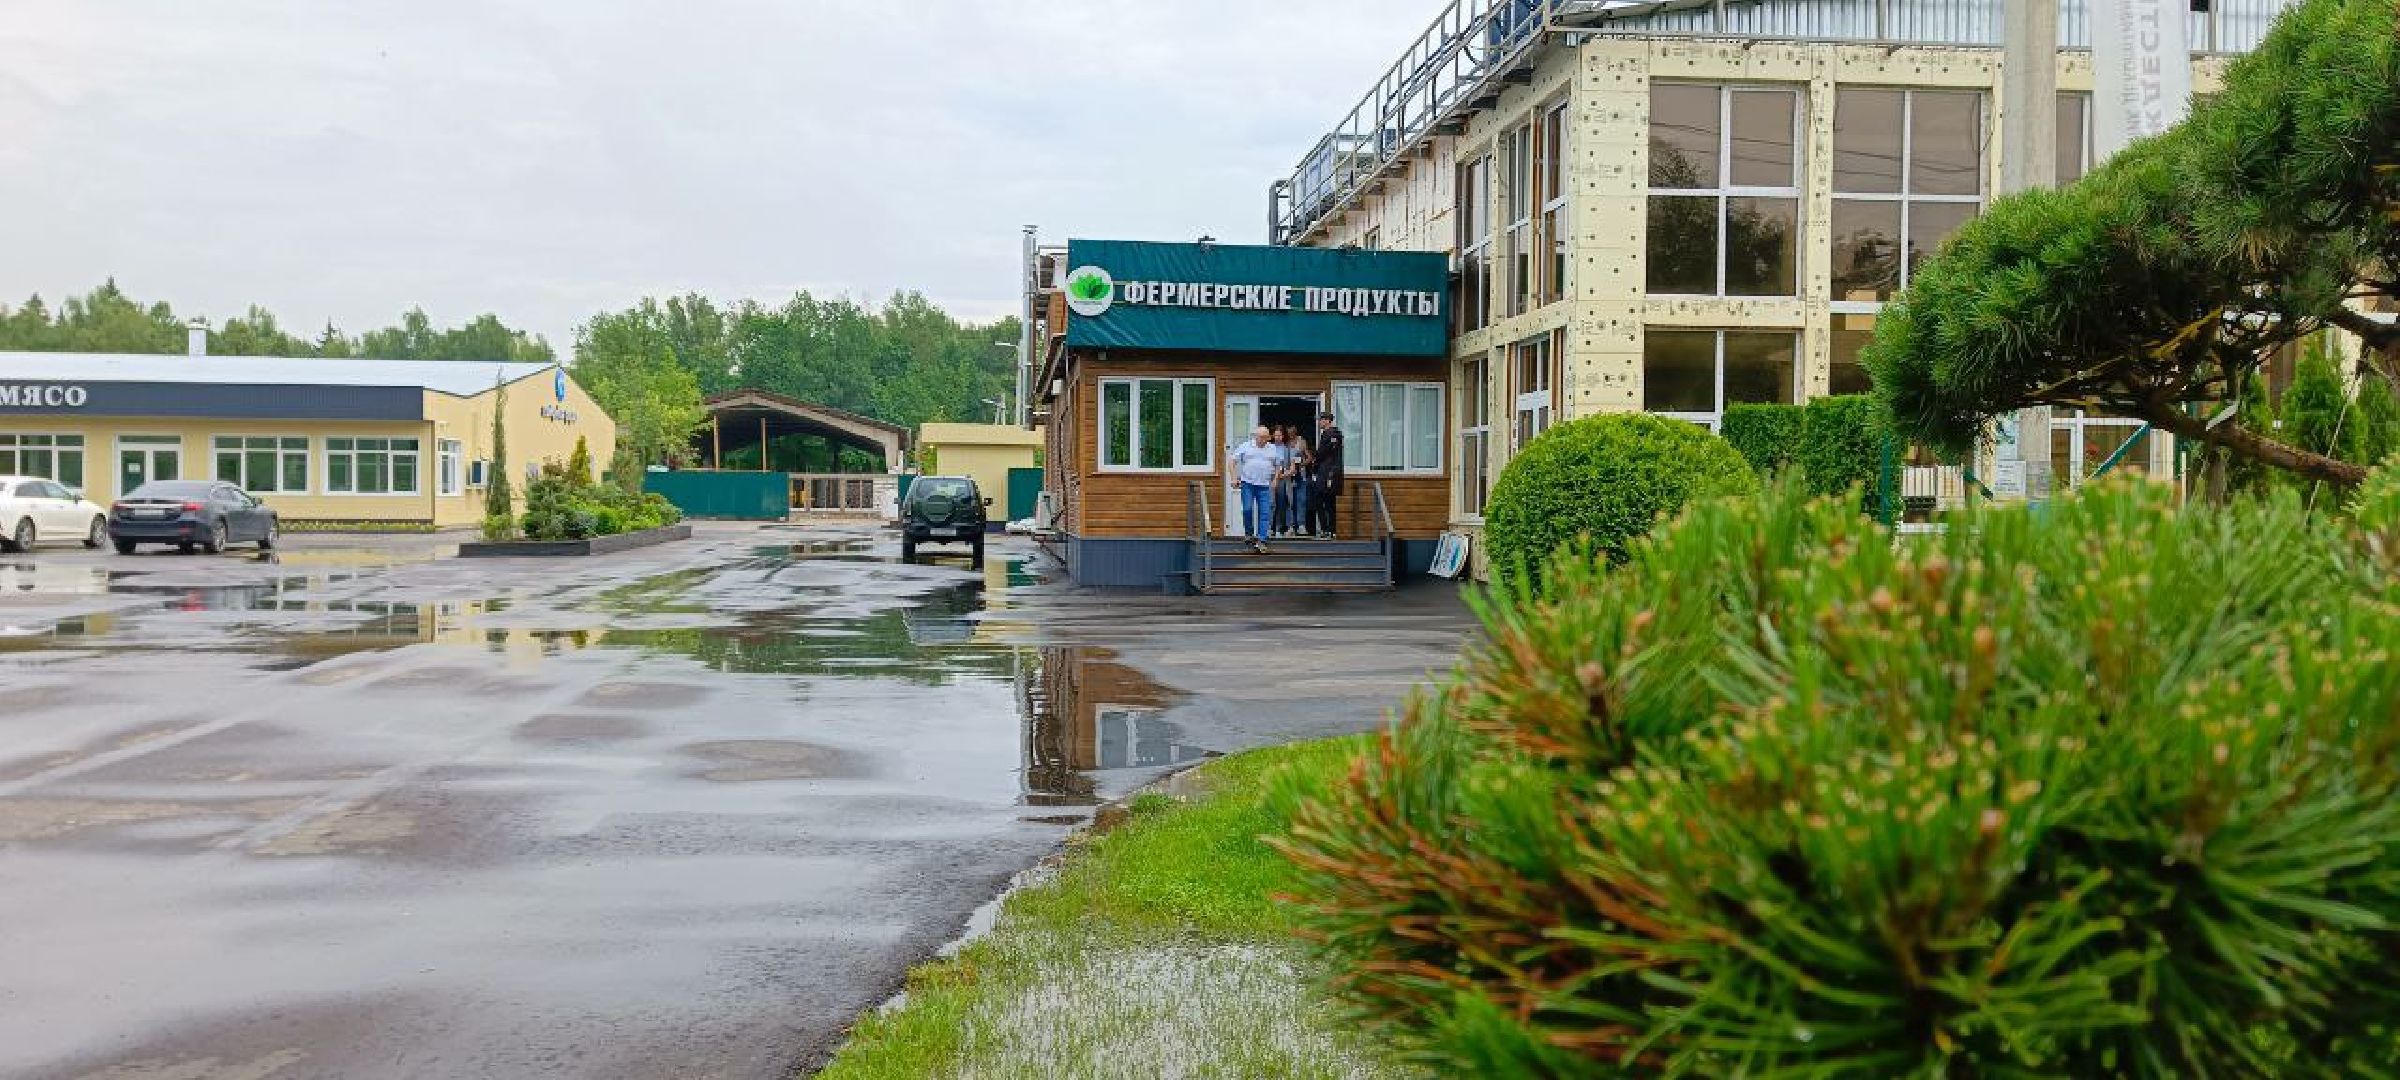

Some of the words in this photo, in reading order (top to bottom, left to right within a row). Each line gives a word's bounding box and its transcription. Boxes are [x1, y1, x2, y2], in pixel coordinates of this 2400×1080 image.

[1124, 281, 1292, 310] ФЕРМЕРСКИЕ
[1305, 287, 1439, 316] ПРОДУКТЫ
[0, 385, 87, 406] МЯСО
